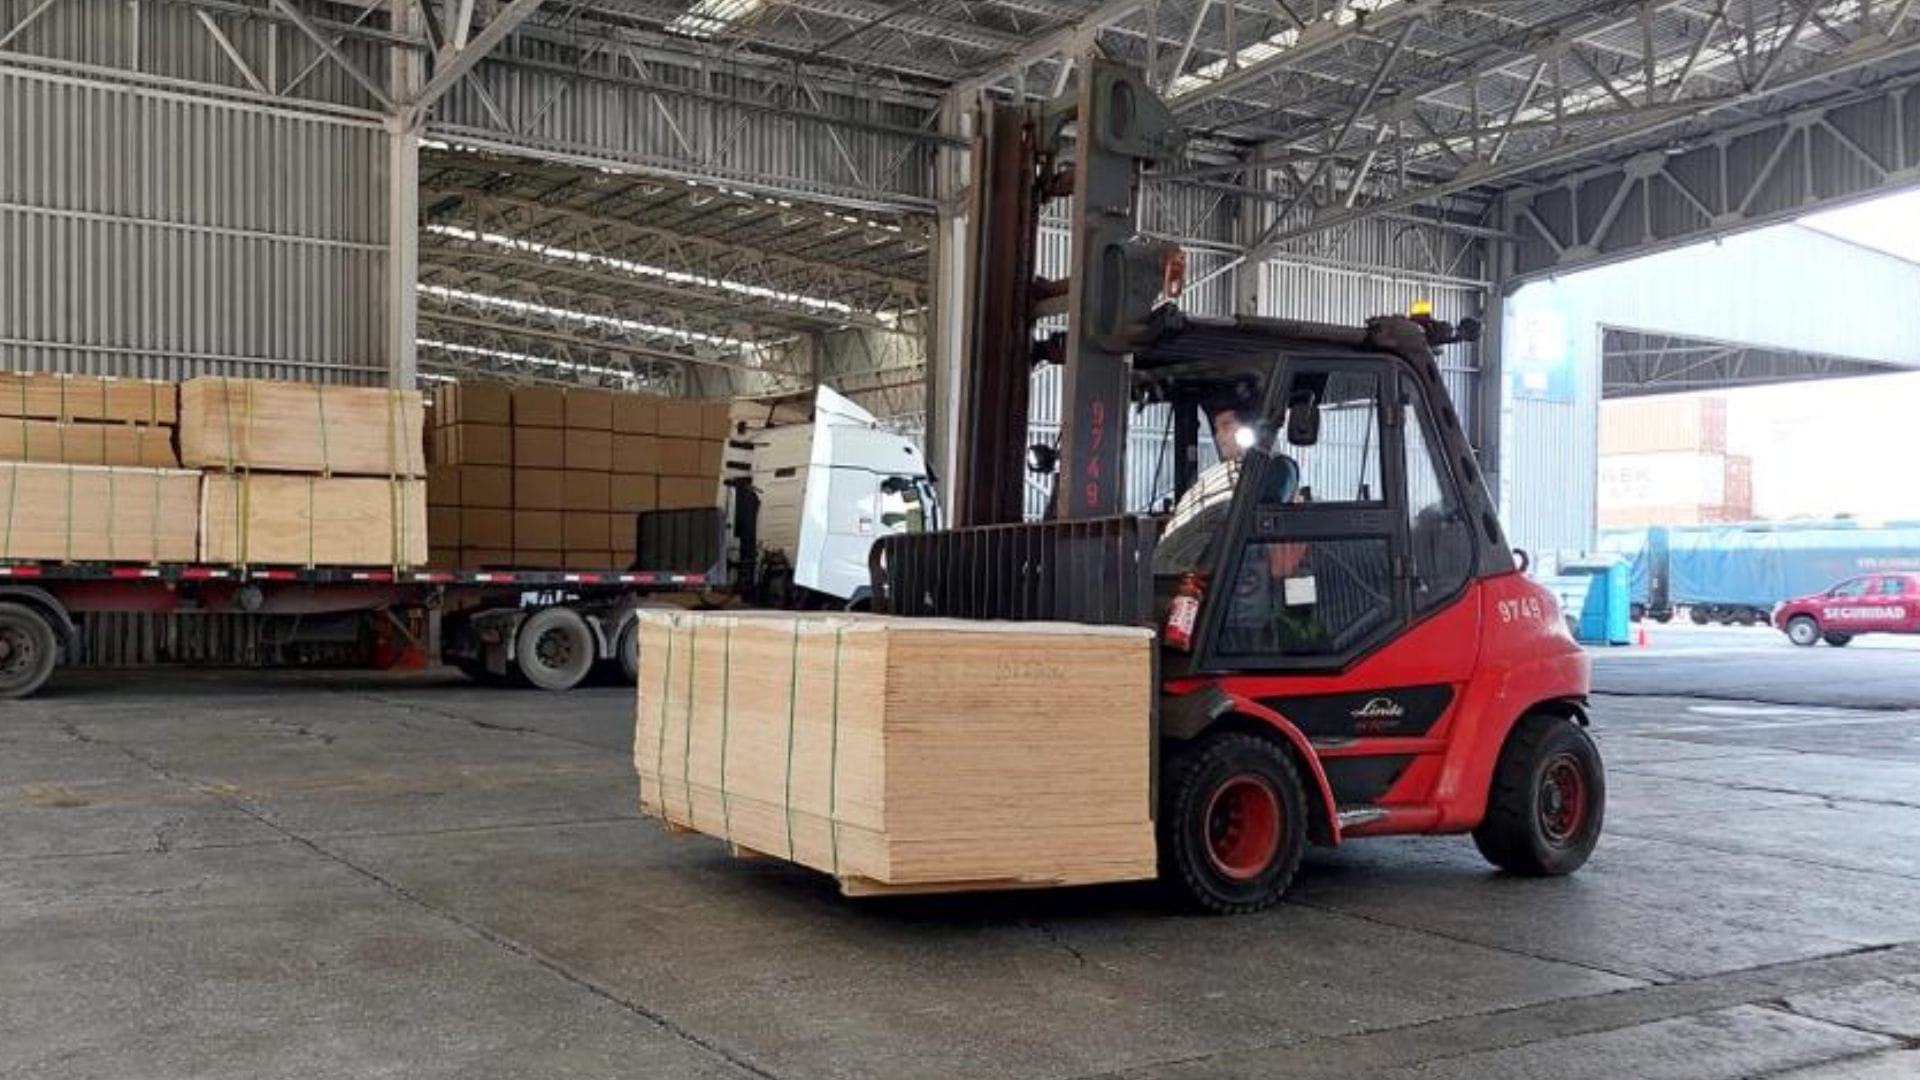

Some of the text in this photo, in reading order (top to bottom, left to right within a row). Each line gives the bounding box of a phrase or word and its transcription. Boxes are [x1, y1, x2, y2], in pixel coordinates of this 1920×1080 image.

[1497, 597, 1541, 623] 9749
[1822, 605, 1906, 620] SEGURIDAD
[1350, 697, 1403, 718] Linde
